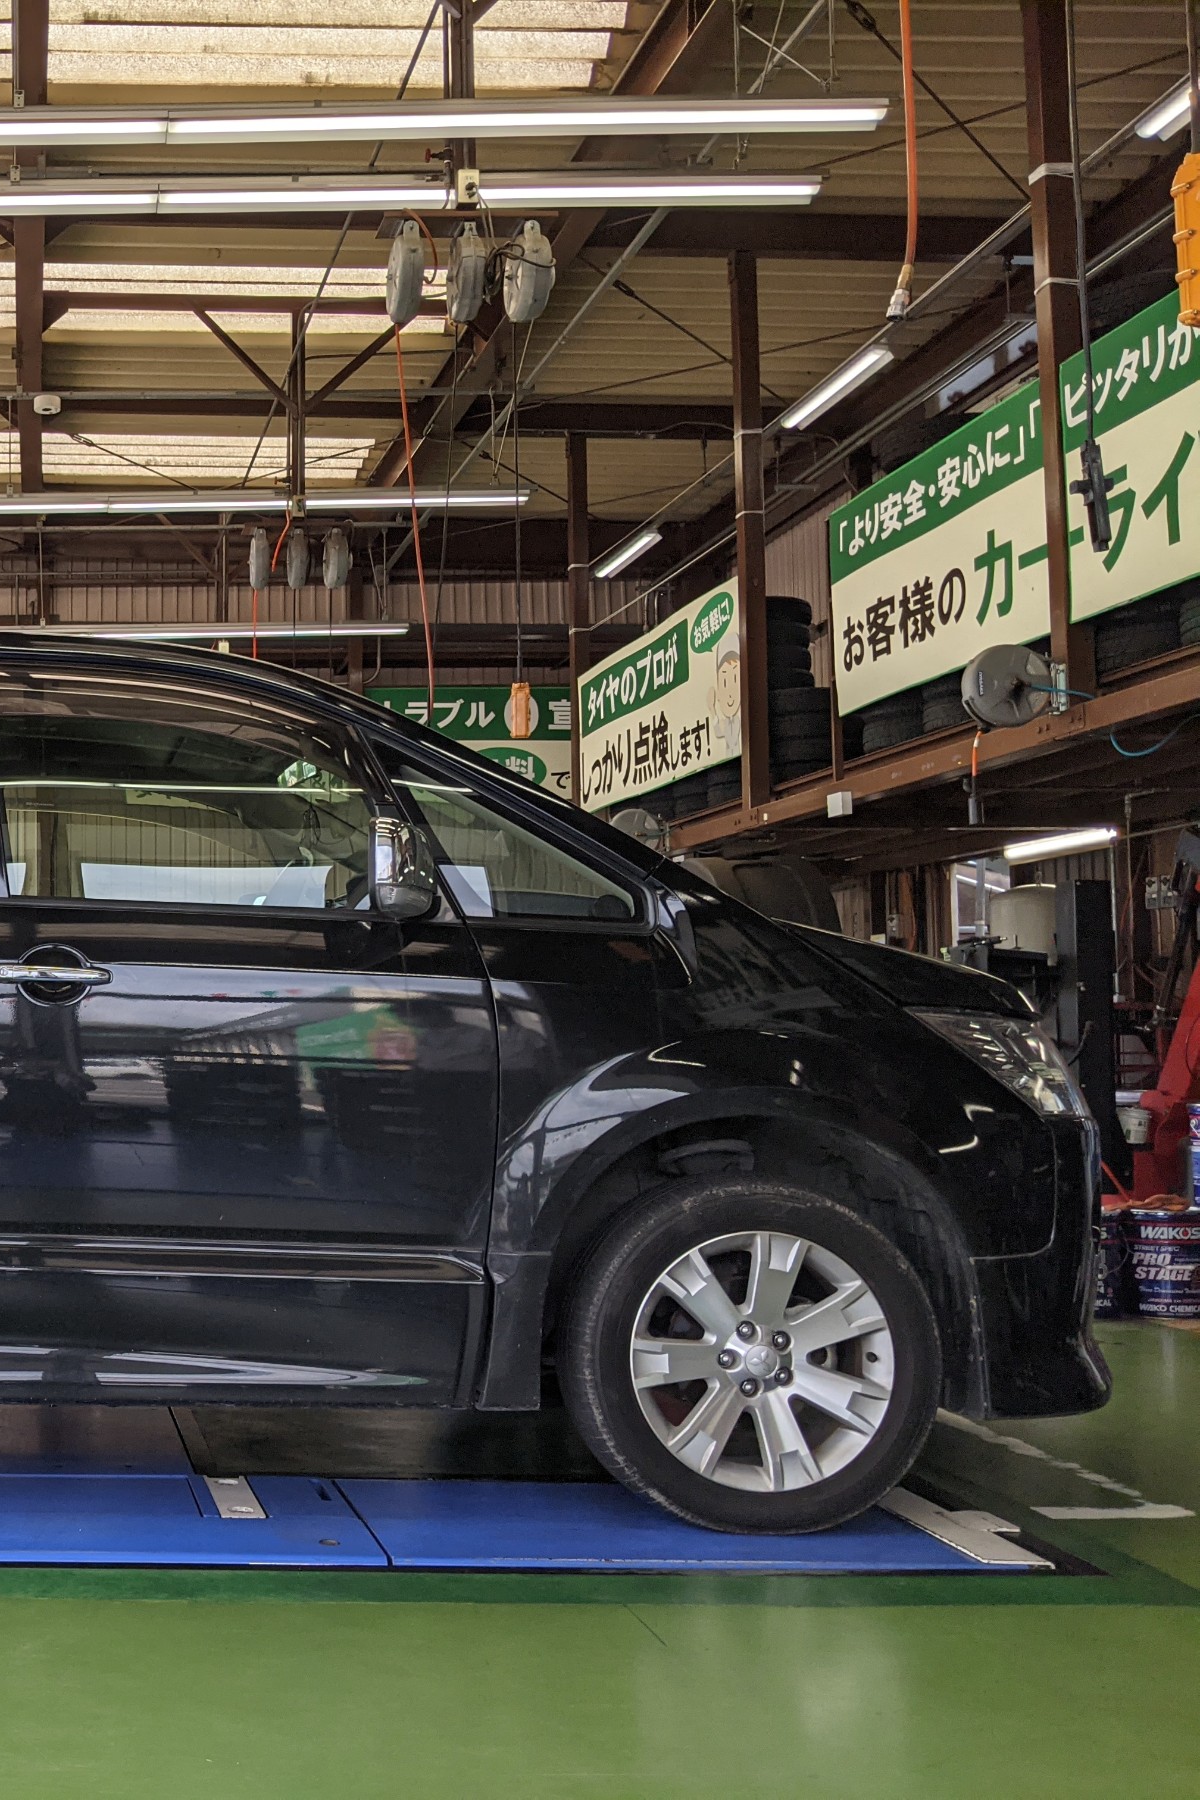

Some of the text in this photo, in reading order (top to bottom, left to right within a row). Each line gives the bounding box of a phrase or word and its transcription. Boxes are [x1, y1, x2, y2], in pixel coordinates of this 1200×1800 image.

[588, 632, 679, 728] タイヤのプロが
[1132, 1252, 1172, 1266] PRO
[1135, 1267, 1191, 1280] STAGE
[1139, 1303, 1167, 1312] WAKO
